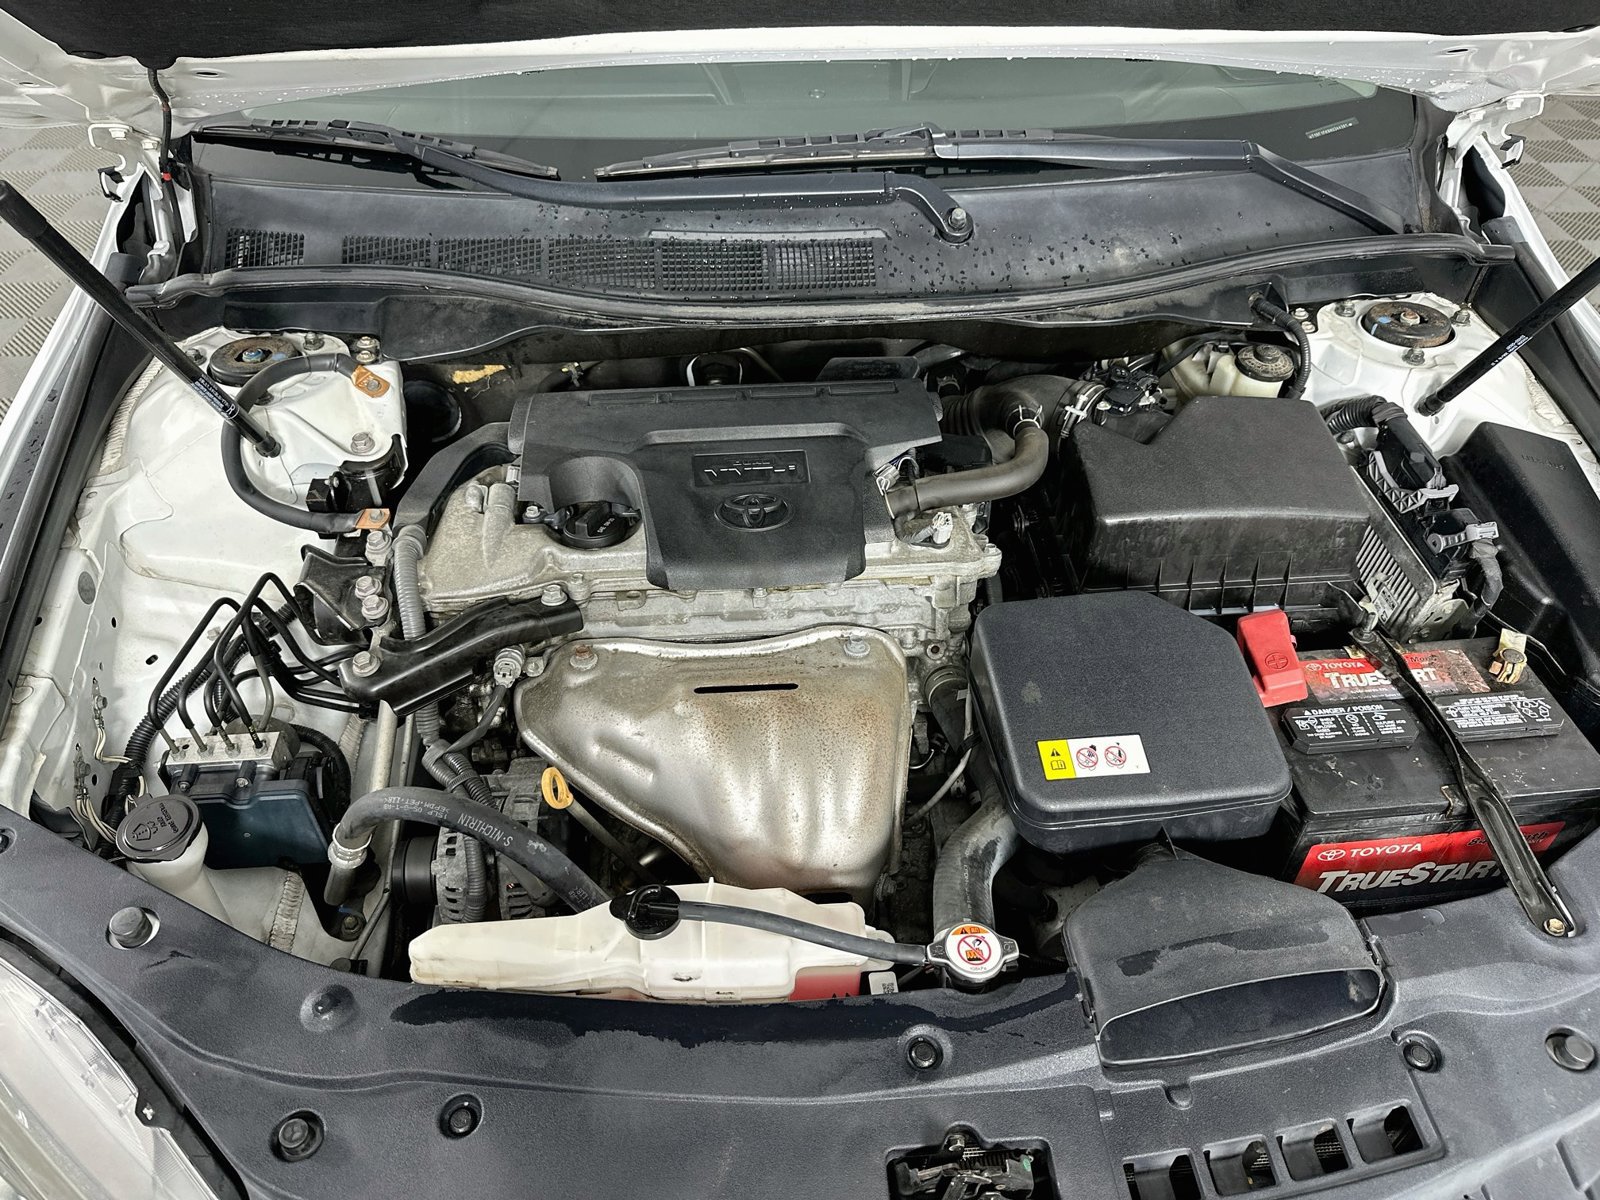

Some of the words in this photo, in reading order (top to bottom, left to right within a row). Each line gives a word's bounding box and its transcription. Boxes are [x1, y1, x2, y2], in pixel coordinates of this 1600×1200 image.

[1321, 661, 1366, 671] TOYOTA
[1311, 706, 1346, 716] DANGER
[1352, 704, 1385, 712] POISON
[1350, 843, 1423, 858] TOYOTA
[1316, 861, 1502, 893] TRUESTAR
